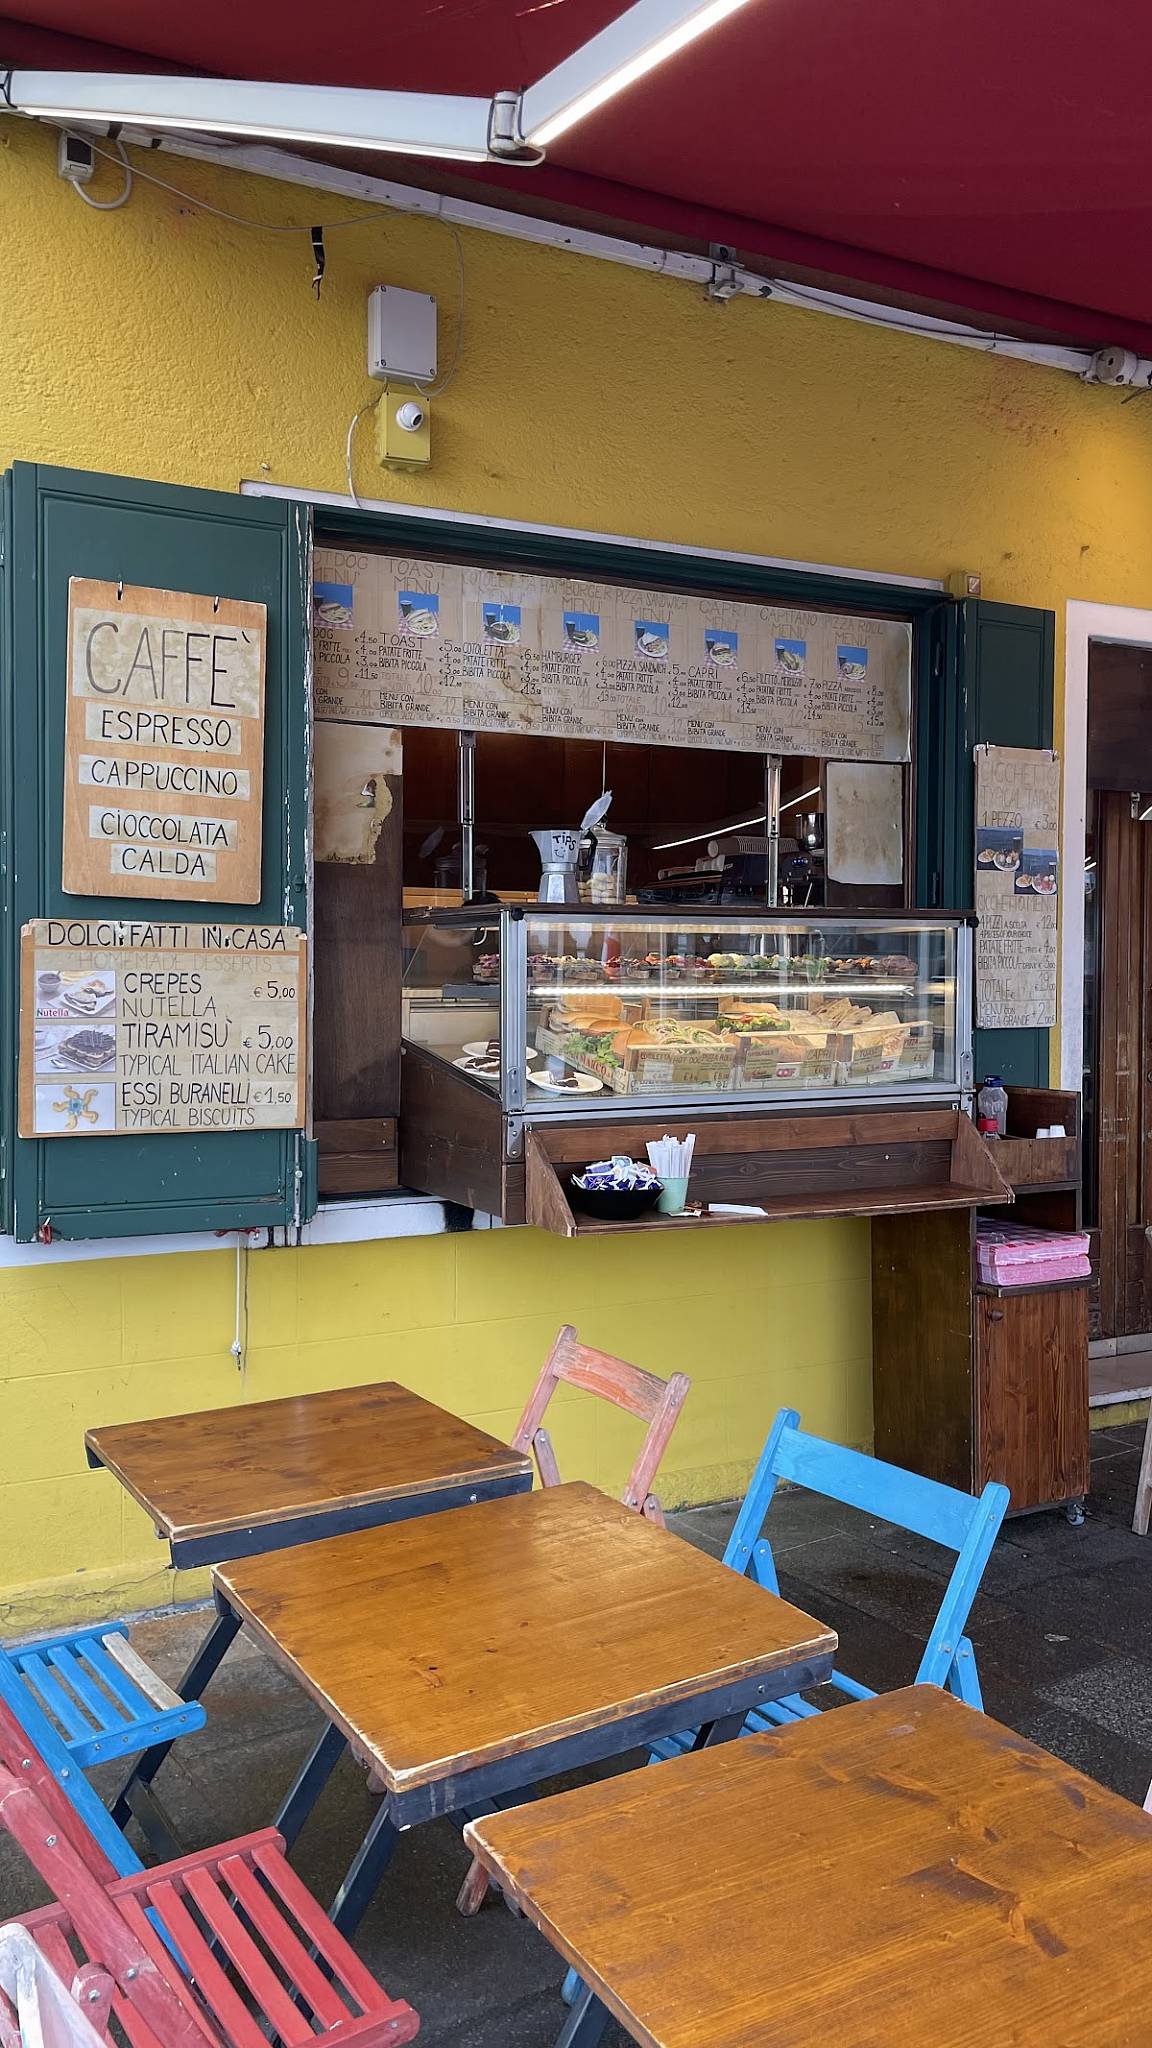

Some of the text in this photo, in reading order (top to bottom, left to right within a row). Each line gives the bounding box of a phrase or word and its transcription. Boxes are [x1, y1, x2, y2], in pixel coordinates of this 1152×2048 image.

[385, 558, 450, 579] TOAST
[380, 631, 427, 650] TOAST
[463, 641, 505, 658] COTOLETTA
[319, 652, 351, 665] PICCOLA
[378, 657, 399, 669] BIBITA
[401, 659, 427, 671] PICCOLA
[541, 650, 582, 665] HAMBURGER
[616, 659, 637, 673] PIZZA
[688, 665, 719, 680] CAPRI
[101, 710, 232, 747] ESPRESSO
[91, 759, 238, 796] CAPPUCCINO
[101, 810, 228, 846] CIOCCOLATA
[990, 811, 1022, 829] PEZZO
[122, 848, 205, 876] CALDA
[48, 922, 286, 951] DOLCI FATTI IN CASA
[123, 972, 202, 995] CREPES
[36, 1008, 69, 1018] Nutella
[122, 995, 217, 1018] NUTELLA
[119, 1050, 297, 1077] TYPICAL ITALIAN CAKE
[121, 1078, 162, 1107] ESSI
[170, 1078, 250, 1106] BURANELLI
[121, 1107, 256, 1127] TYPICAL BISCUITS
